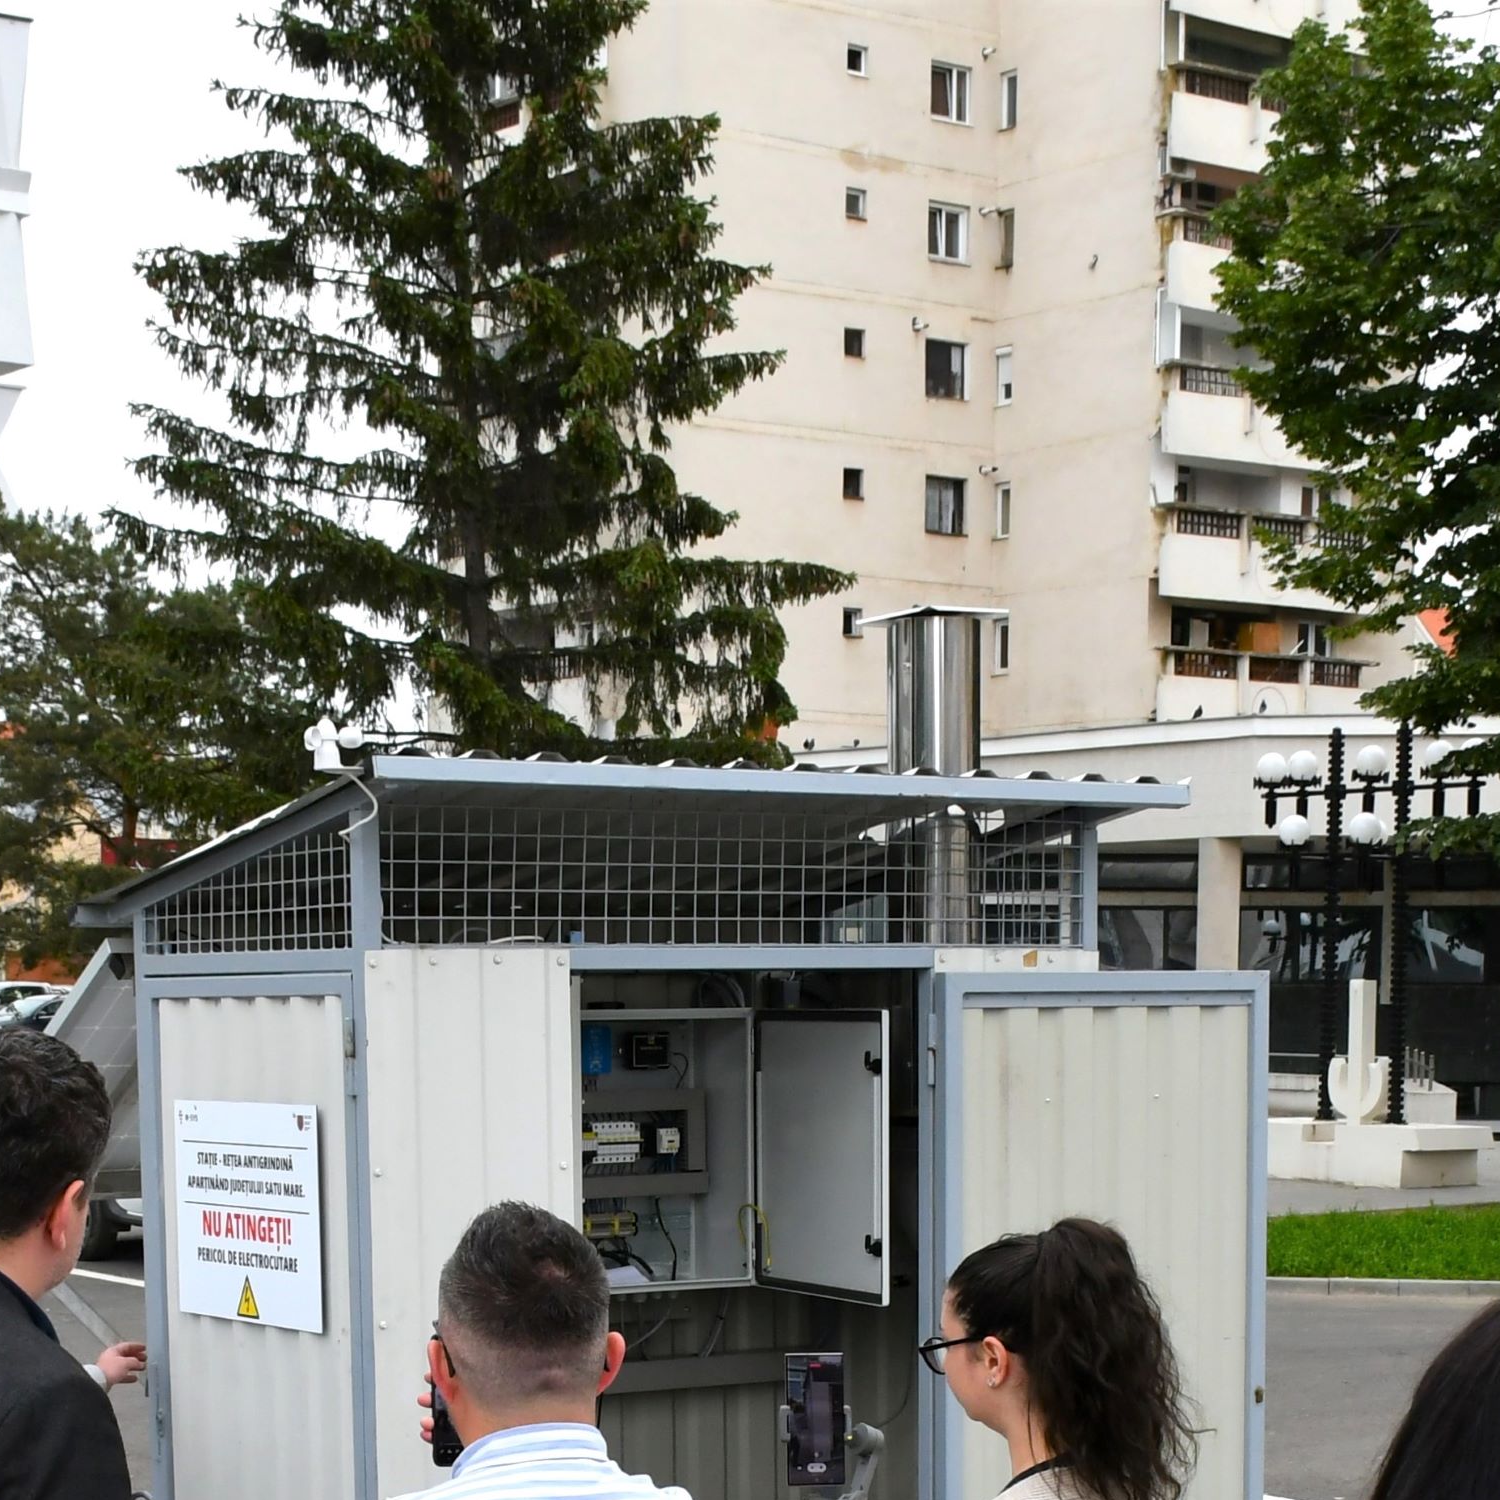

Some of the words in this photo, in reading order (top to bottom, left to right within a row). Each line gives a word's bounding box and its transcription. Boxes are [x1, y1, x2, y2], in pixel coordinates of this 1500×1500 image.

[265, 1182, 282, 1196] SATU
[283, 1184, 305, 1198] MARE.
[202, 1210, 221, 1237] NU
[225, 1212, 291, 1251] ATINGEȚI!
[198, 1247, 226, 1264] PERICOL
[228, 1251, 237, 1266] DE
[239, 1252, 298, 1273] ELECTROCUTARE
